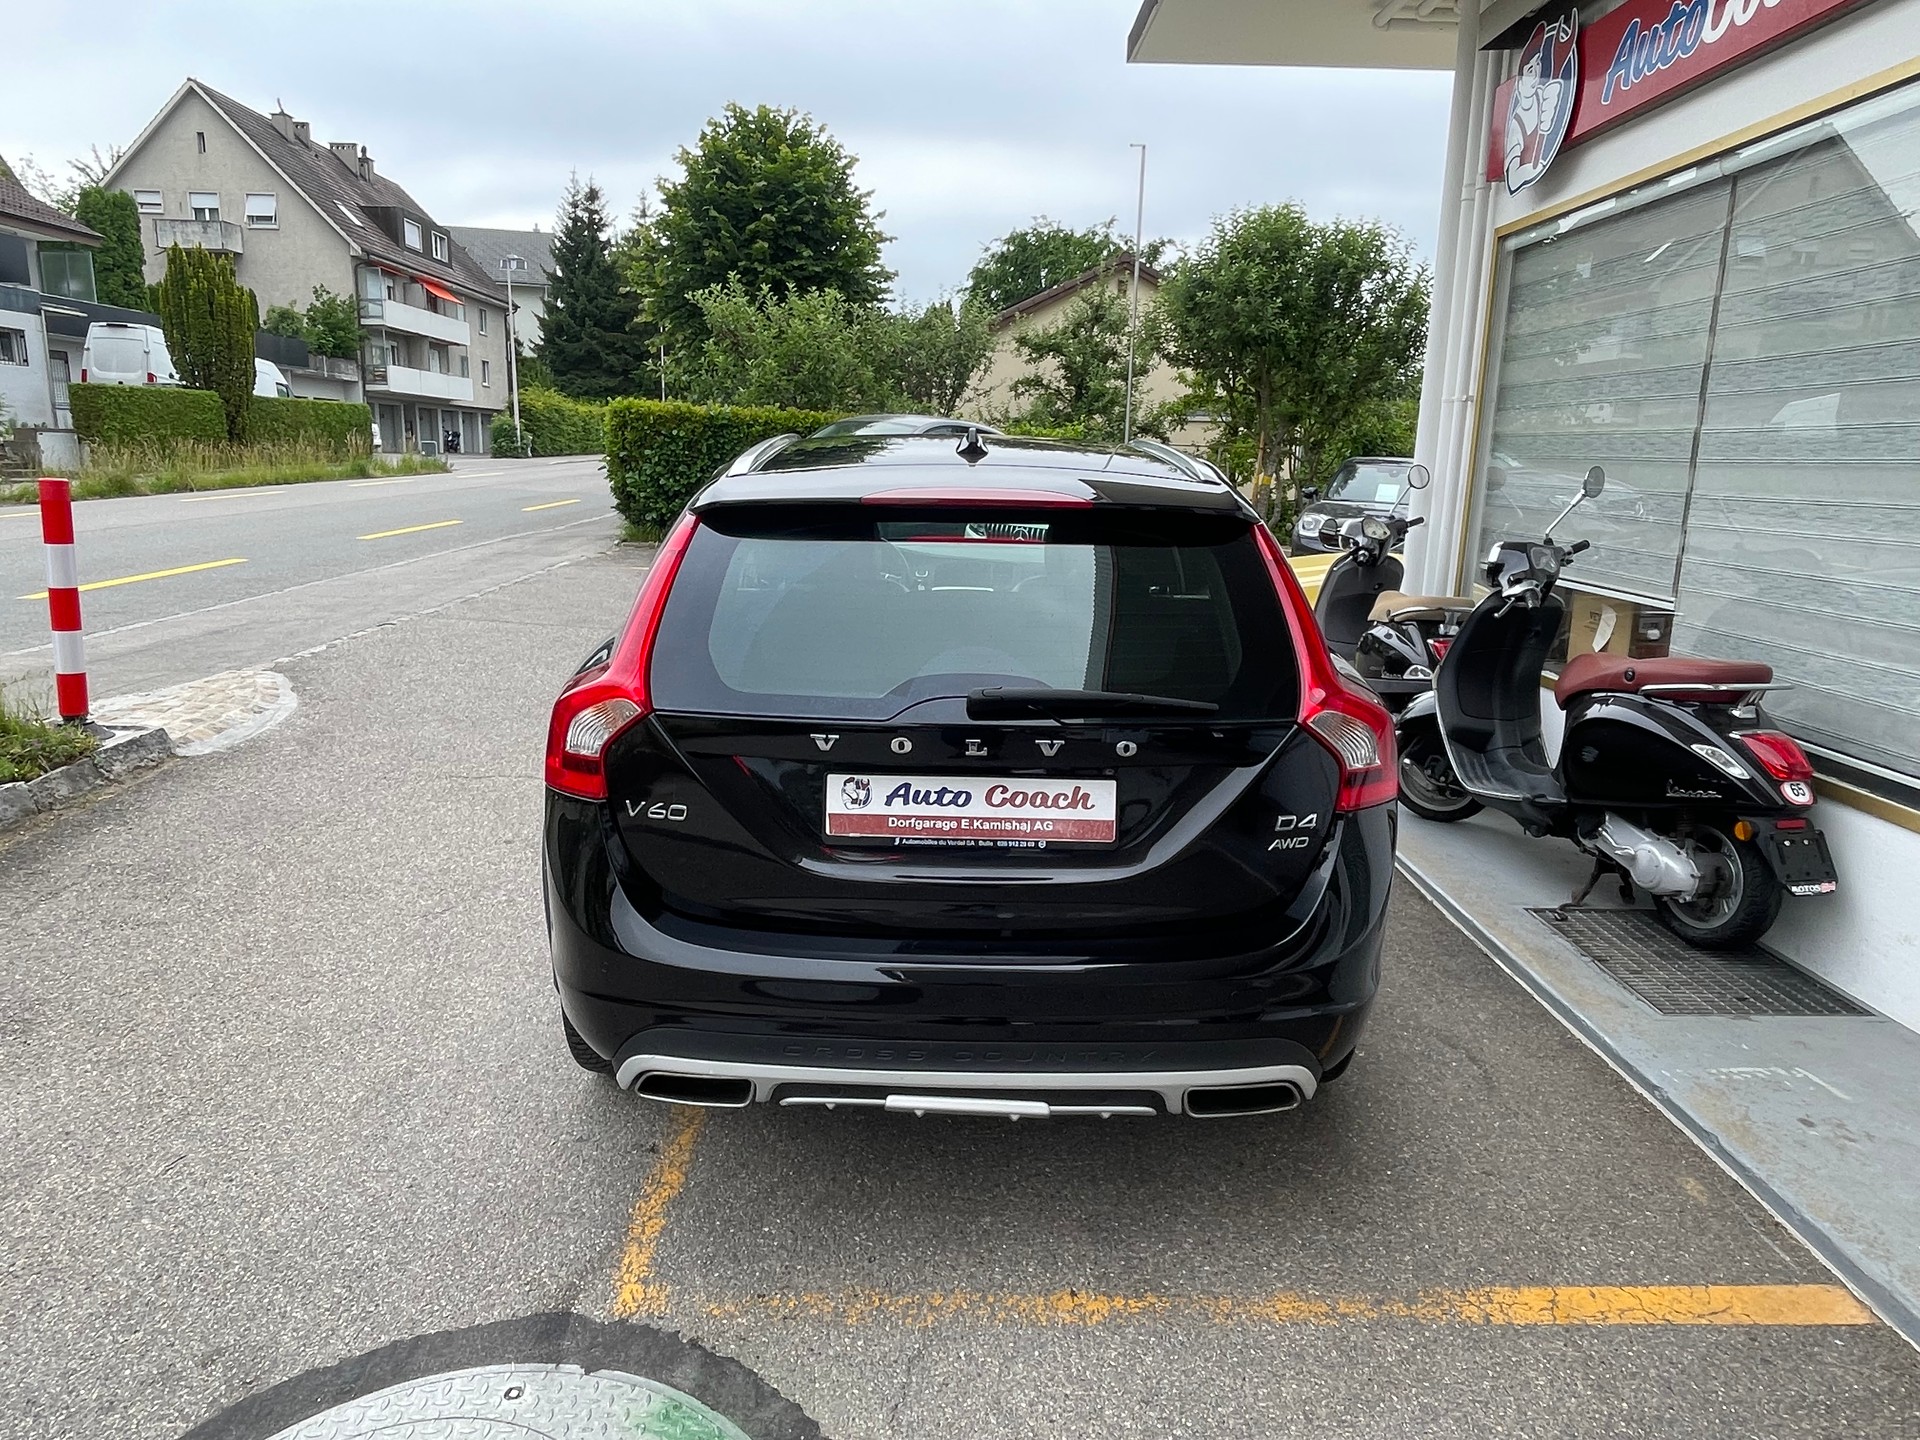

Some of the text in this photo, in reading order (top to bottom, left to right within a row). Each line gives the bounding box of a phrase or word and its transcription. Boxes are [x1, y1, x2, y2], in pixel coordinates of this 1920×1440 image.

[810, 733, 1138, 758] VOLVO
[884, 782, 1095, 810] Auto Coach
[1790, 783, 1806, 797] 65
[625, 800, 687, 821] V60
[888, 817, 1053, 833] Dorfgarage E.Kamishaj AG
[1275, 813, 1317, 831] D4
[1268, 837, 1309, 851] AWD
[783, 1046, 1157, 1063] CROSS COUNTRY
